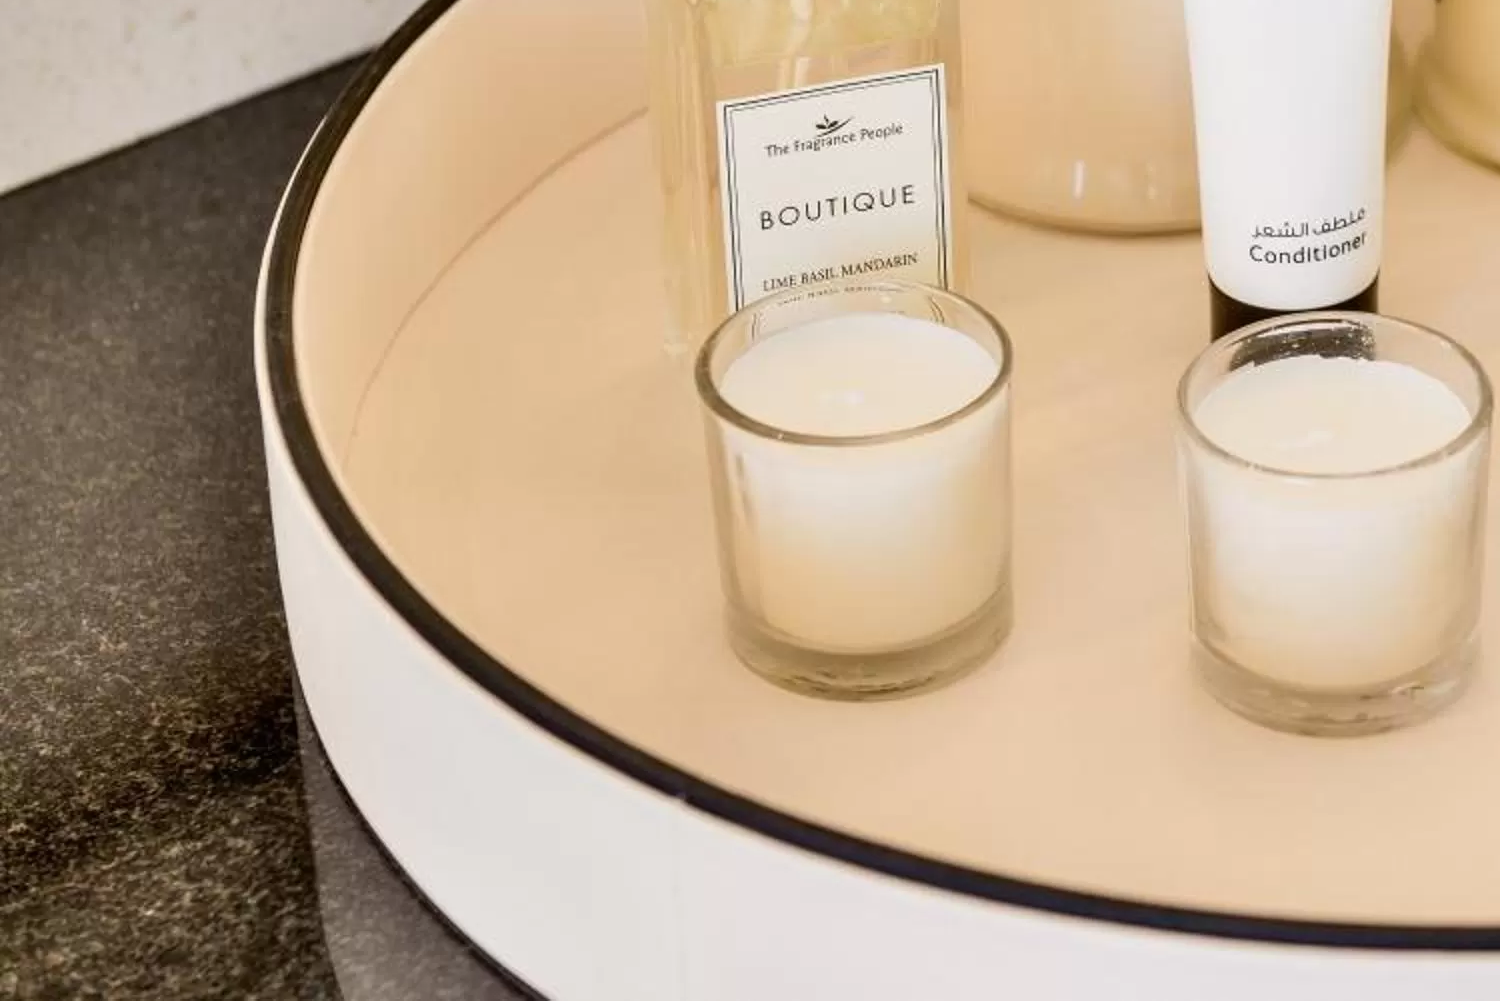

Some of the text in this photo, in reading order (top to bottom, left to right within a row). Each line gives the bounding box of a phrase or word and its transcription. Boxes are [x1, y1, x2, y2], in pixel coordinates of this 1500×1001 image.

[764, 123, 904, 158] The Fragrance People
[760, 184, 916, 231] BOUTIQUE
[1249, 230, 1368, 264] Conditioner
[1251, 221, 1310, 240] الشعر
[763, 252, 919, 292] LIME BASIL MANDARIN
